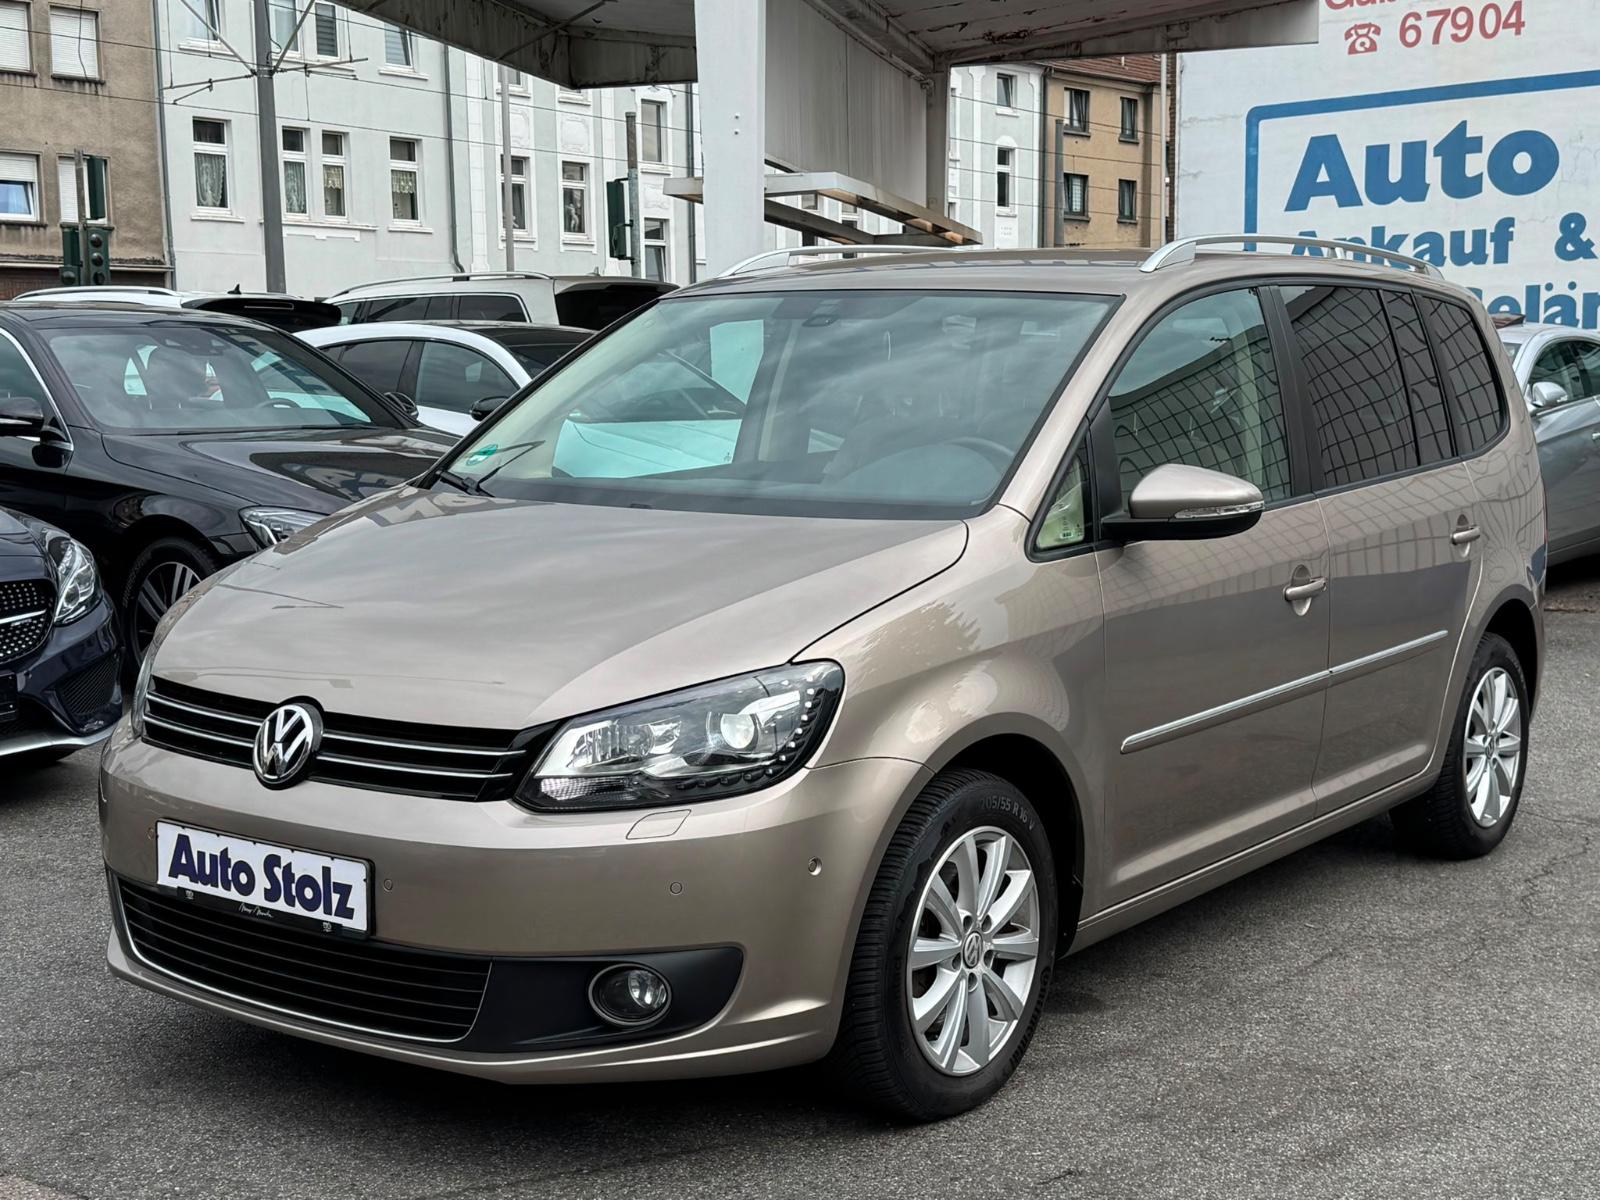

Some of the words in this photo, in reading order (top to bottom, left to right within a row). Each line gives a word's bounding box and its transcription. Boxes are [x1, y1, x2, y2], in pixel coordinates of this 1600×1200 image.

[1399, 1, 1526, 49] 67904
[1284, 120, 1560, 212] Auto
[1554, 212, 1598, 262] &
[168, 834, 255, 896] Auto
[263, 854, 355, 920] Stolz
